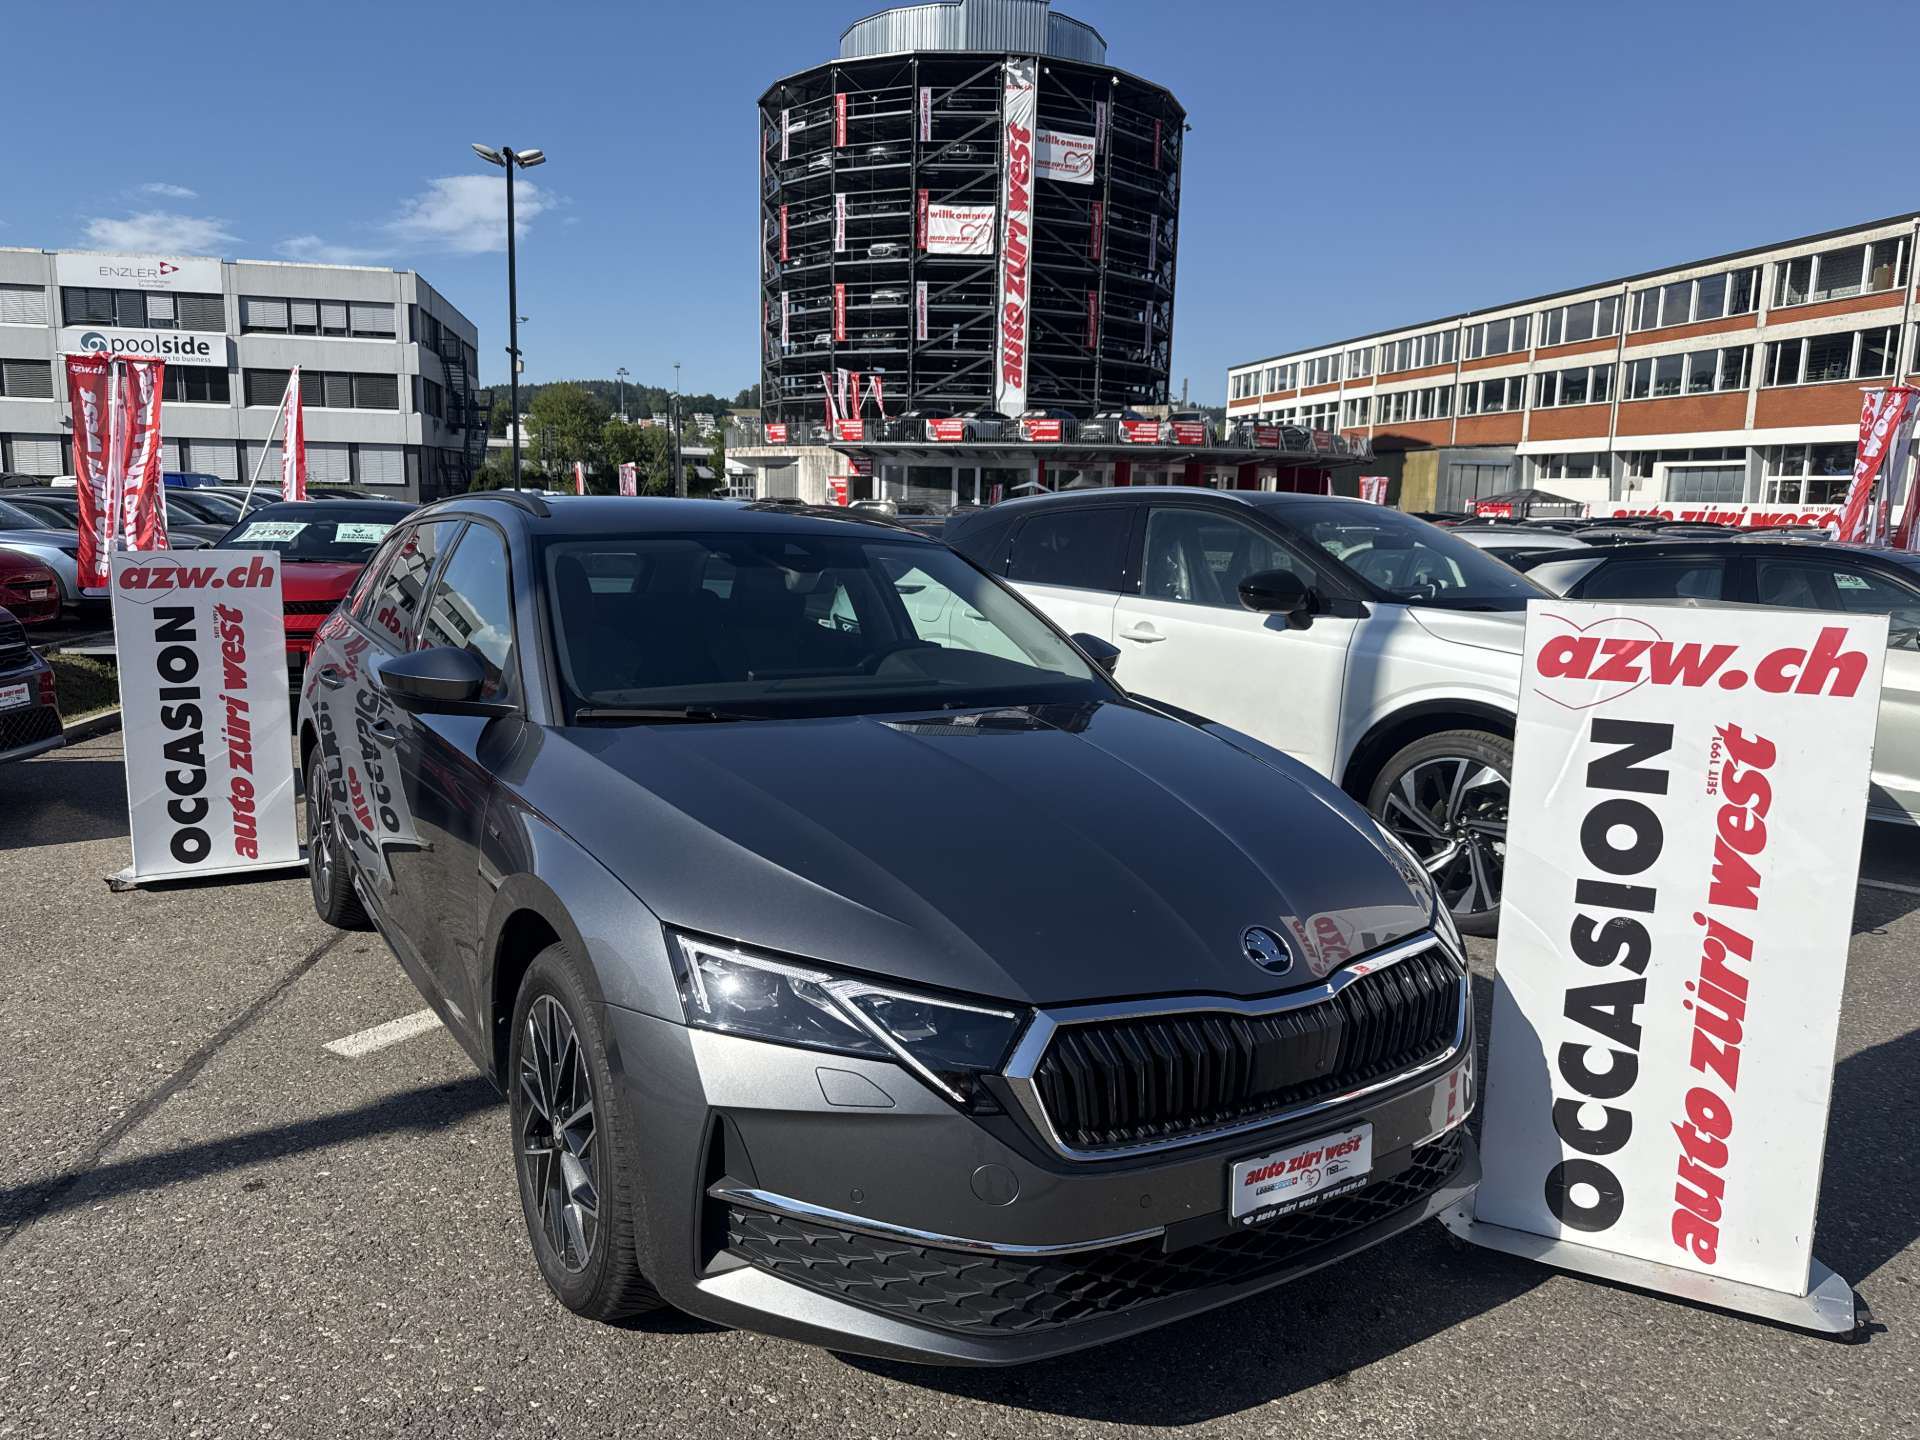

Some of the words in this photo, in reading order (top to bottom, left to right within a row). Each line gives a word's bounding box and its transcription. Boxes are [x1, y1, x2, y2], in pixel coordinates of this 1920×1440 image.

[1008, 121, 1031, 212] west
[1037, 134, 1094, 150] willkommen
[99, 266, 158, 279] ENZLER
[111, 335, 211, 356] poolside
[181, 355, 212, 363] business
[1003, 302, 1025, 389] auto
[119, 556, 275, 590] azw.ch
[214, 603, 248, 690] west
[1536, 627, 1868, 698] azw.ch
[153, 606, 212, 864] OCCASION
[218, 694, 253, 774] züri
[1710, 736, 1723, 765] 1991
[228, 776, 258, 860] auto
[1706, 769, 1719, 796] SEIT
[1708, 722, 1777, 911] west
[1544, 717, 1675, 1234] OCCASION
[1683, 911, 1754, 1094] züri
[1245, 1161, 1286, 1186] auto
[1287, 1145, 1325, 1172] züri
[1325, 1134, 1362, 1159] west
[1670, 1088, 1733, 1266] auto
[1255, 1207, 1277, 1222] auto
[1298, 1195, 1319, 1211] west
